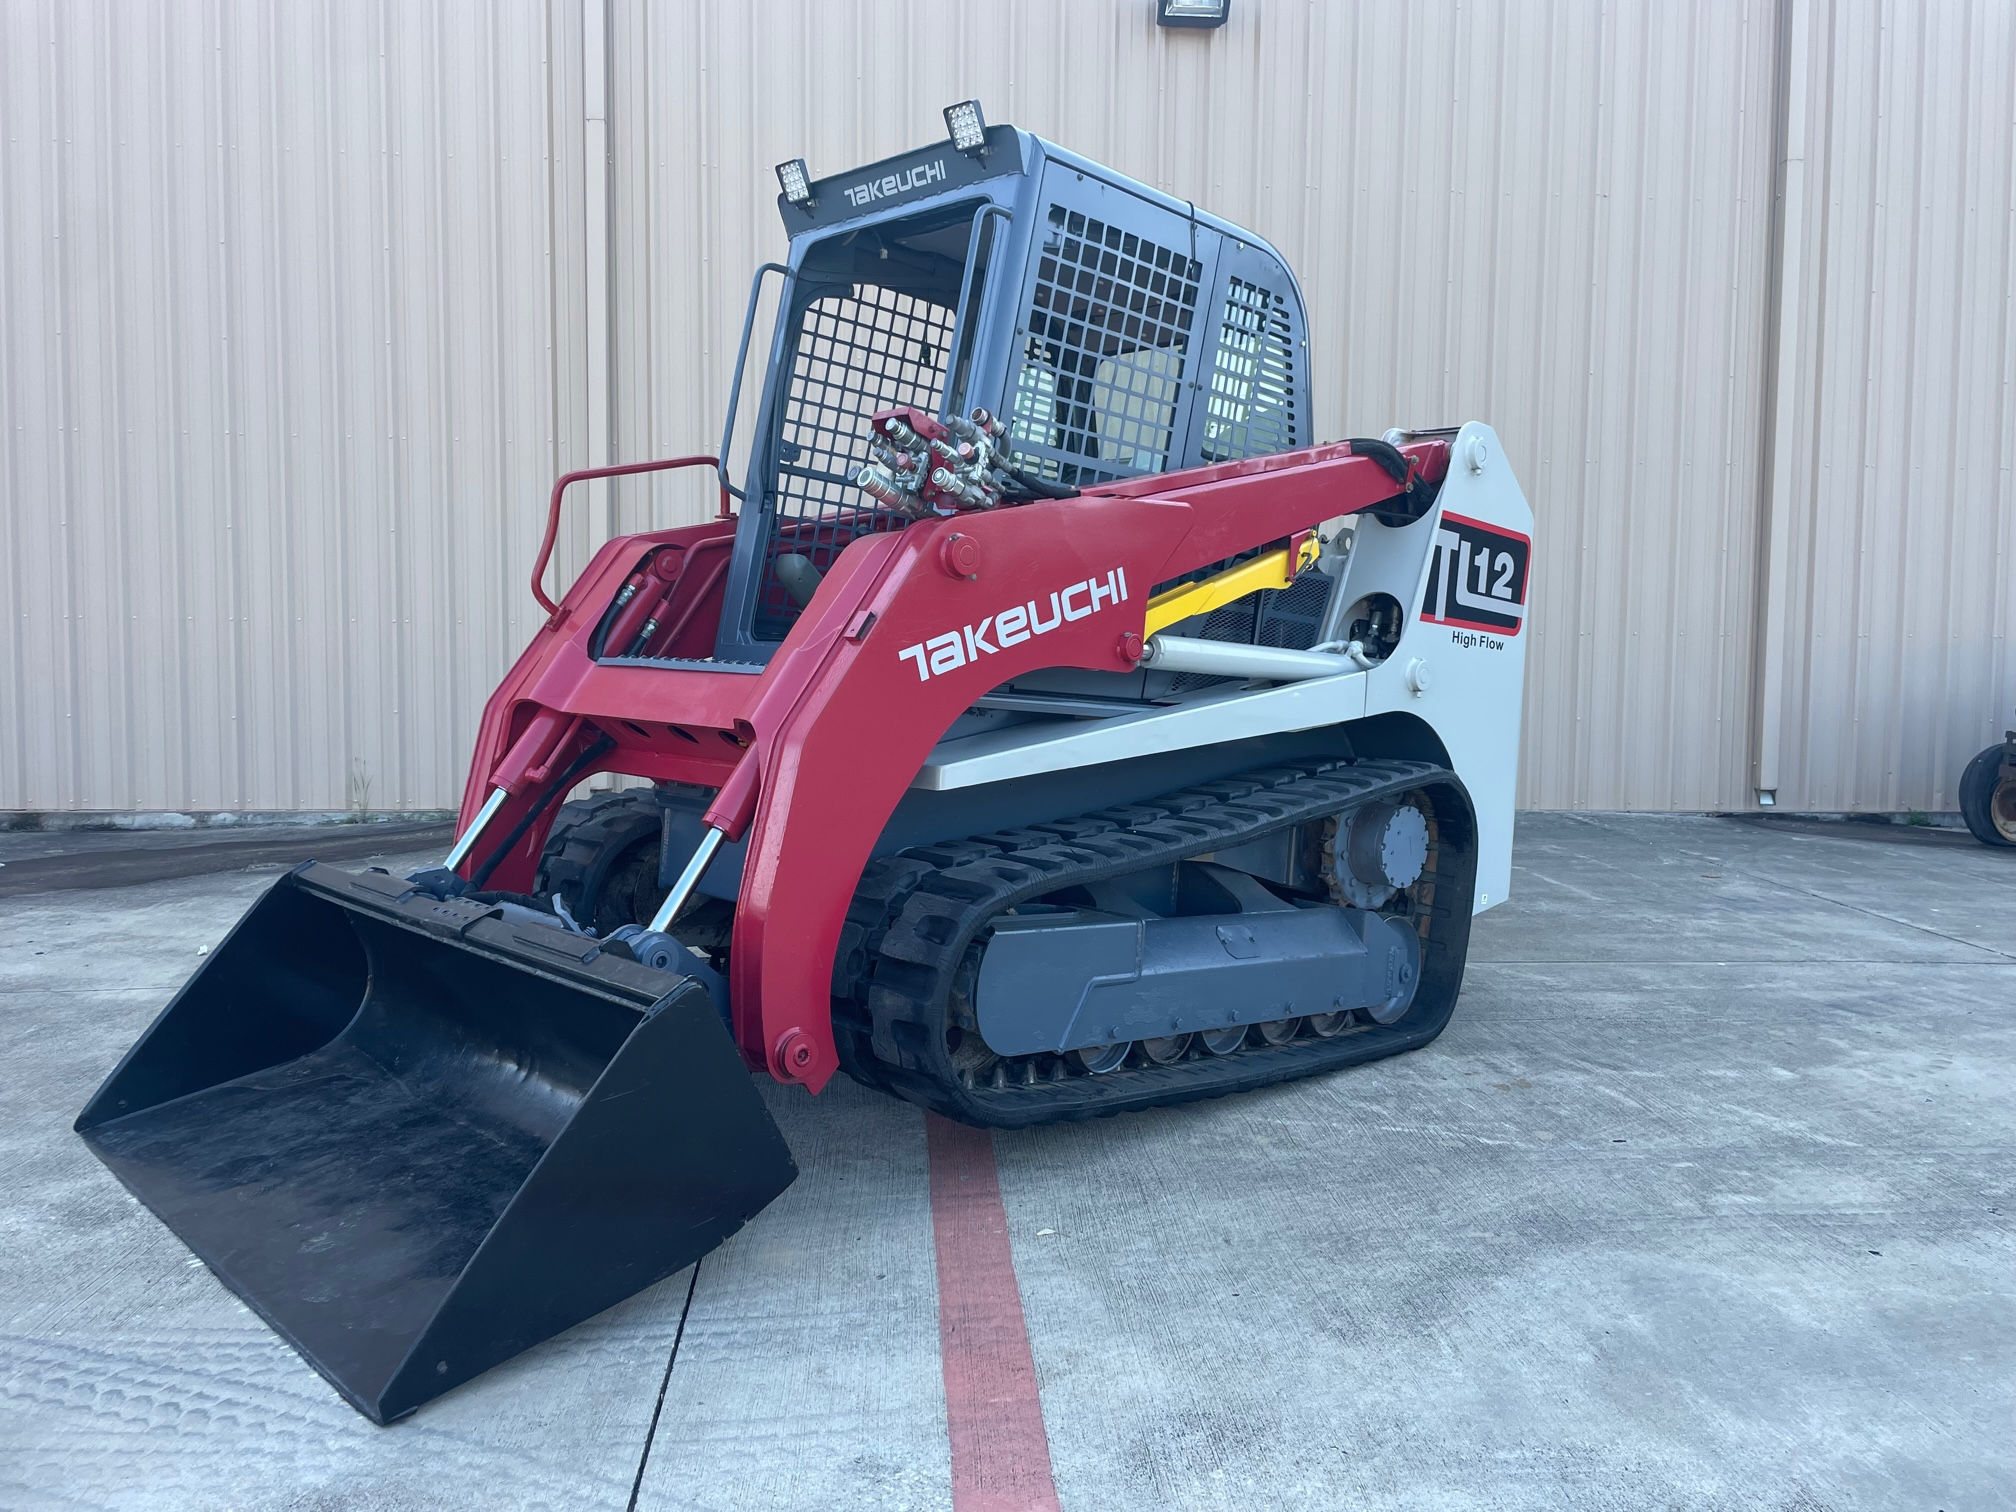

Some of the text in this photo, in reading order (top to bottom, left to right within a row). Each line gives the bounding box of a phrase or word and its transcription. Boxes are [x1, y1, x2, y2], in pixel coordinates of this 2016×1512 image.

[844, 160, 946, 207] TAKEUCHI
[898, 566, 1128, 682] TAKEUCHI
[1452, 631, 1504, 651] High Flow
